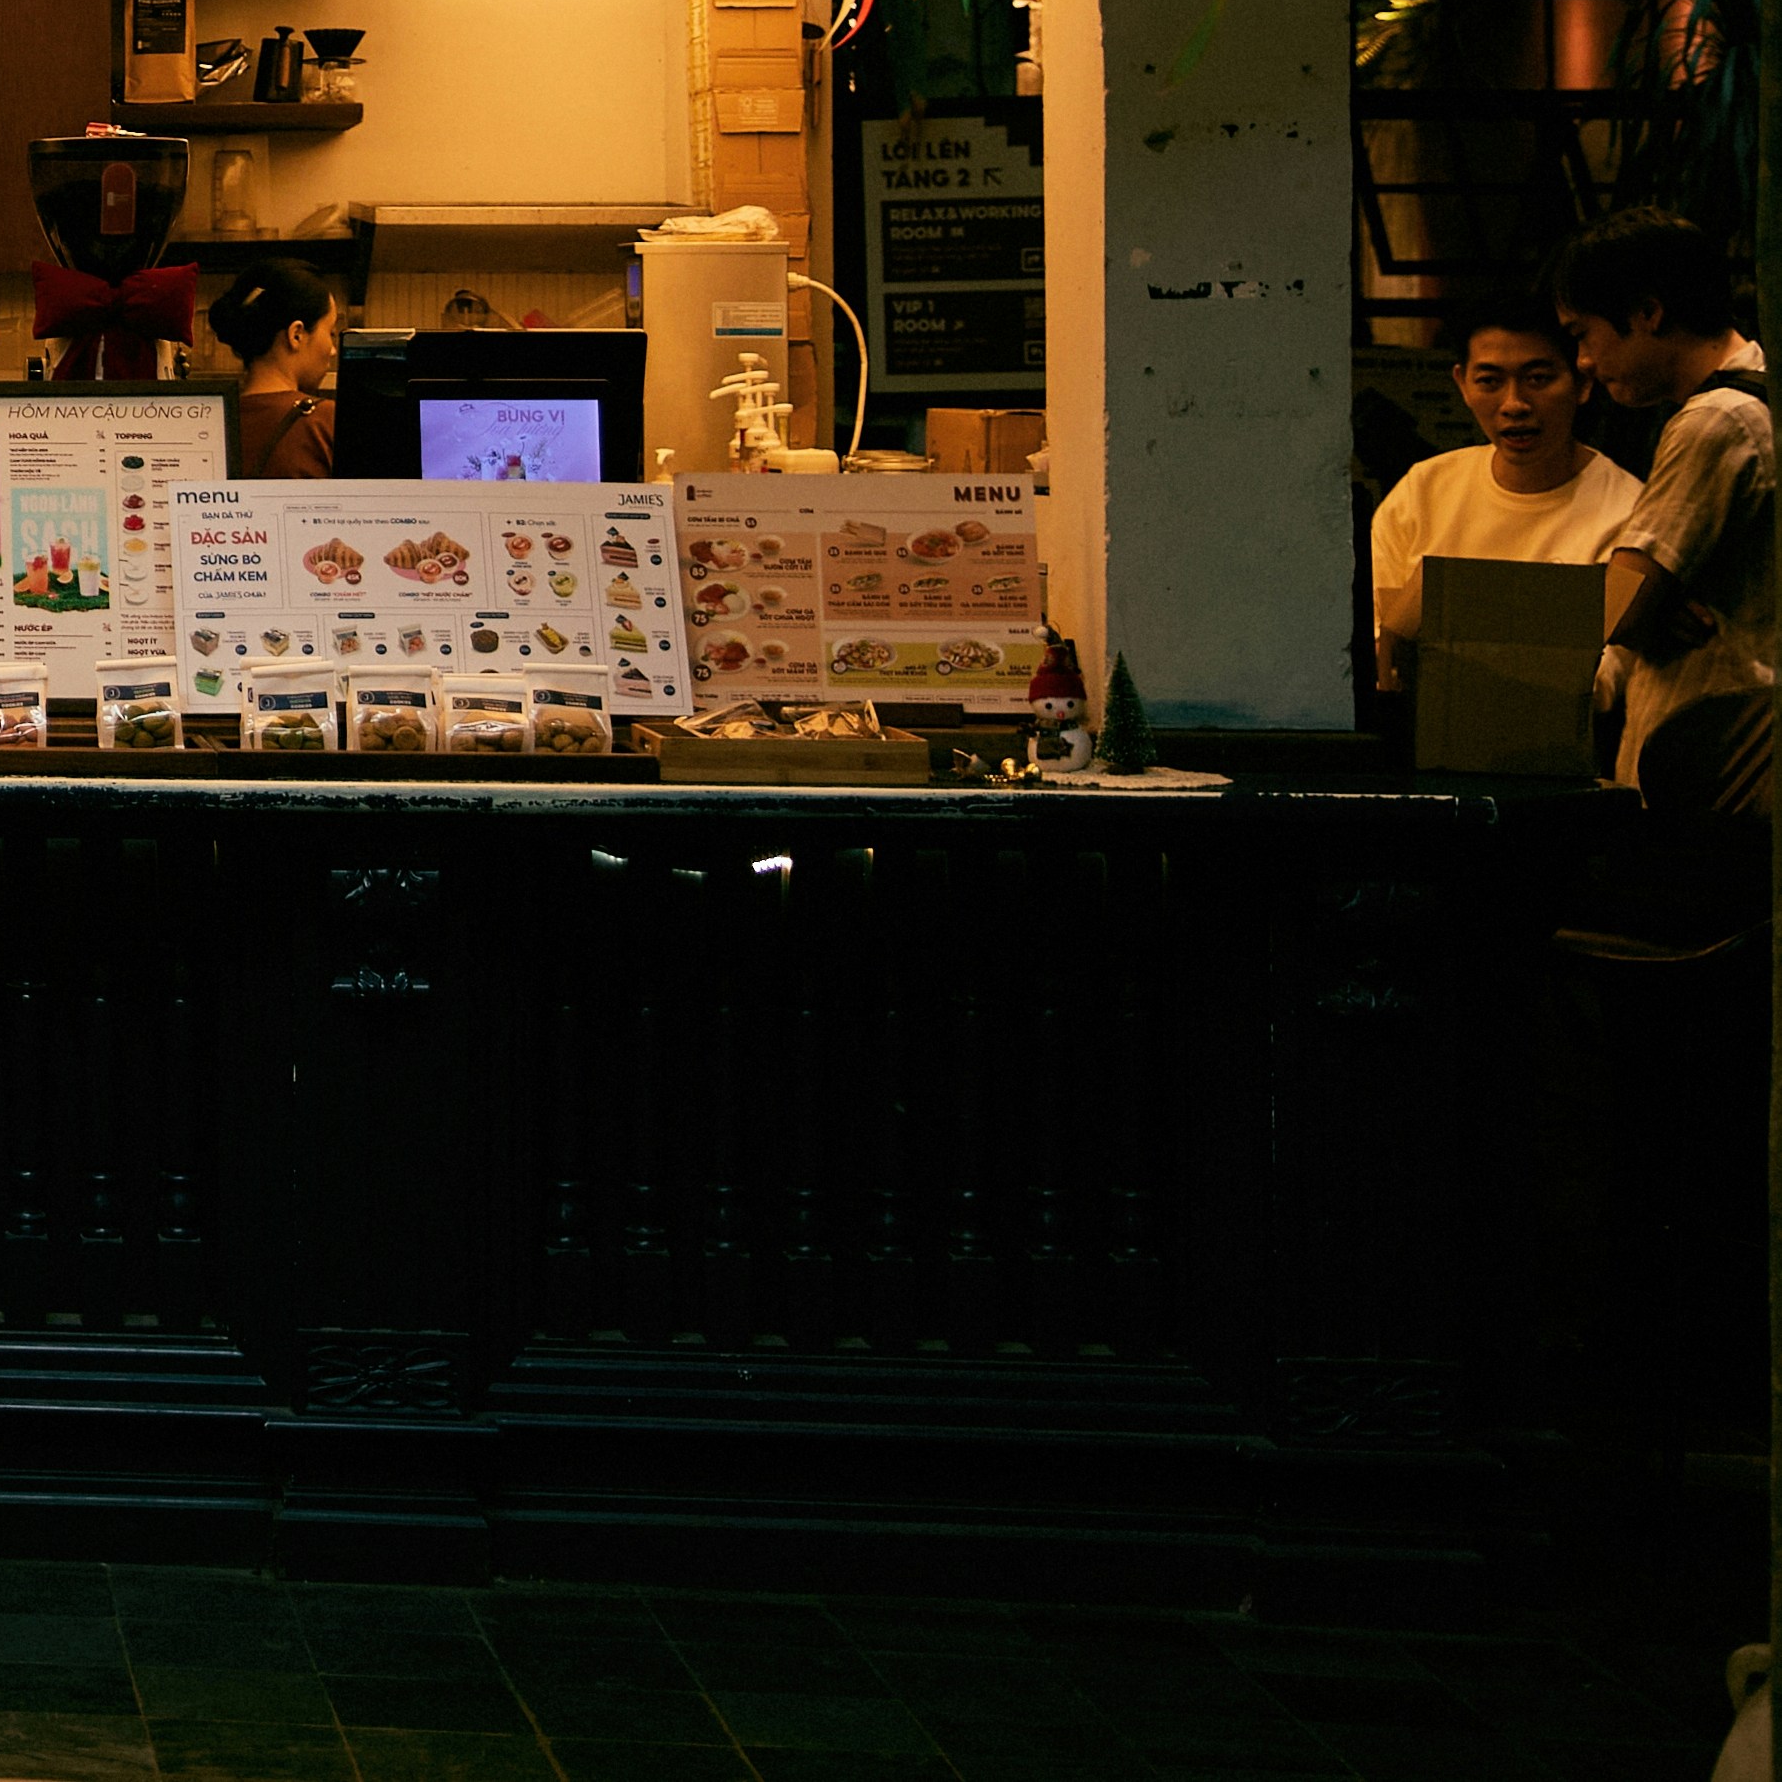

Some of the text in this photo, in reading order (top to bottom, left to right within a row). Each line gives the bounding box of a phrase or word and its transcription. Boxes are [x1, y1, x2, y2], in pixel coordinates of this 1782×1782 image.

[957, 168, 971, 187] 2
[890, 225, 942, 240] ROOM
[893, 319, 946, 333] ROOM
[8, 402, 213, 422] HÔM NAY CẬU UỐNG GÌ?
[547, 409, 566, 426] VỊ
[9, 430, 49, 441] HOA QUẢ
[115, 433, 154, 441] TOPPING
[177, 490, 240, 505] menu
[953, 485, 1022, 503] MENU
[190, 526, 268, 549] ĐẶC SẢN
[200, 550, 262, 566] SỪNG BÒ
[193, 567, 268, 583] CHẤM KEM
[691, 567, 706, 577] 85
[14, 621, 53, 632] NƯỚC ÉP
[694, 614, 706, 624] 75
[696, 668, 709, 678] 75
